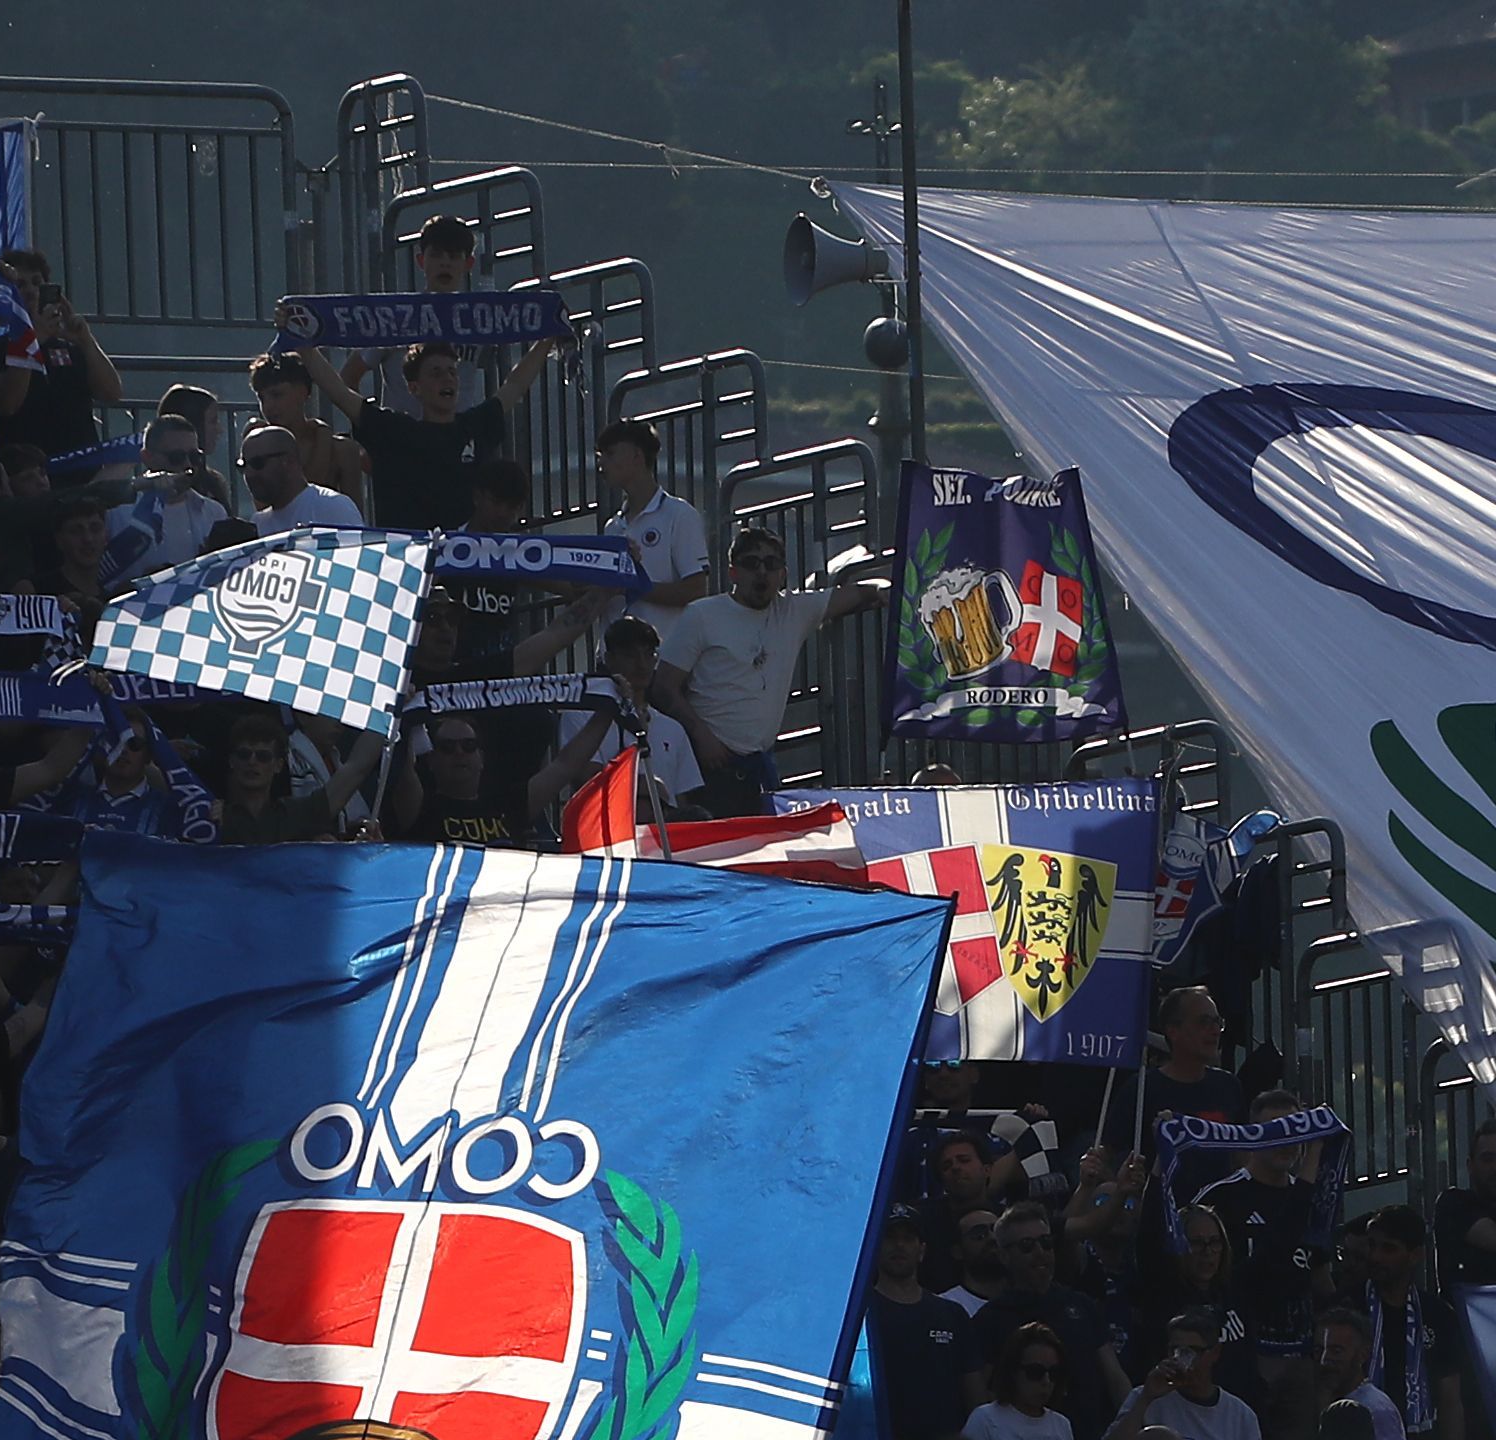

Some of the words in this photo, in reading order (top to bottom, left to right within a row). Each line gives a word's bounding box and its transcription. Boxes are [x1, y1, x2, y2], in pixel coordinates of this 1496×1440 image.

[333, 303, 444, 341] FORZA
[453, 302, 543, 337] COMO
[569, 551, 602, 566] 1907
[15, 597, 55, 630] 1907
[966, 689, 1049, 705] RODERO
[1065, 1031, 1128, 1058] 1907
[1160, 1115, 1264, 1146] COMO
